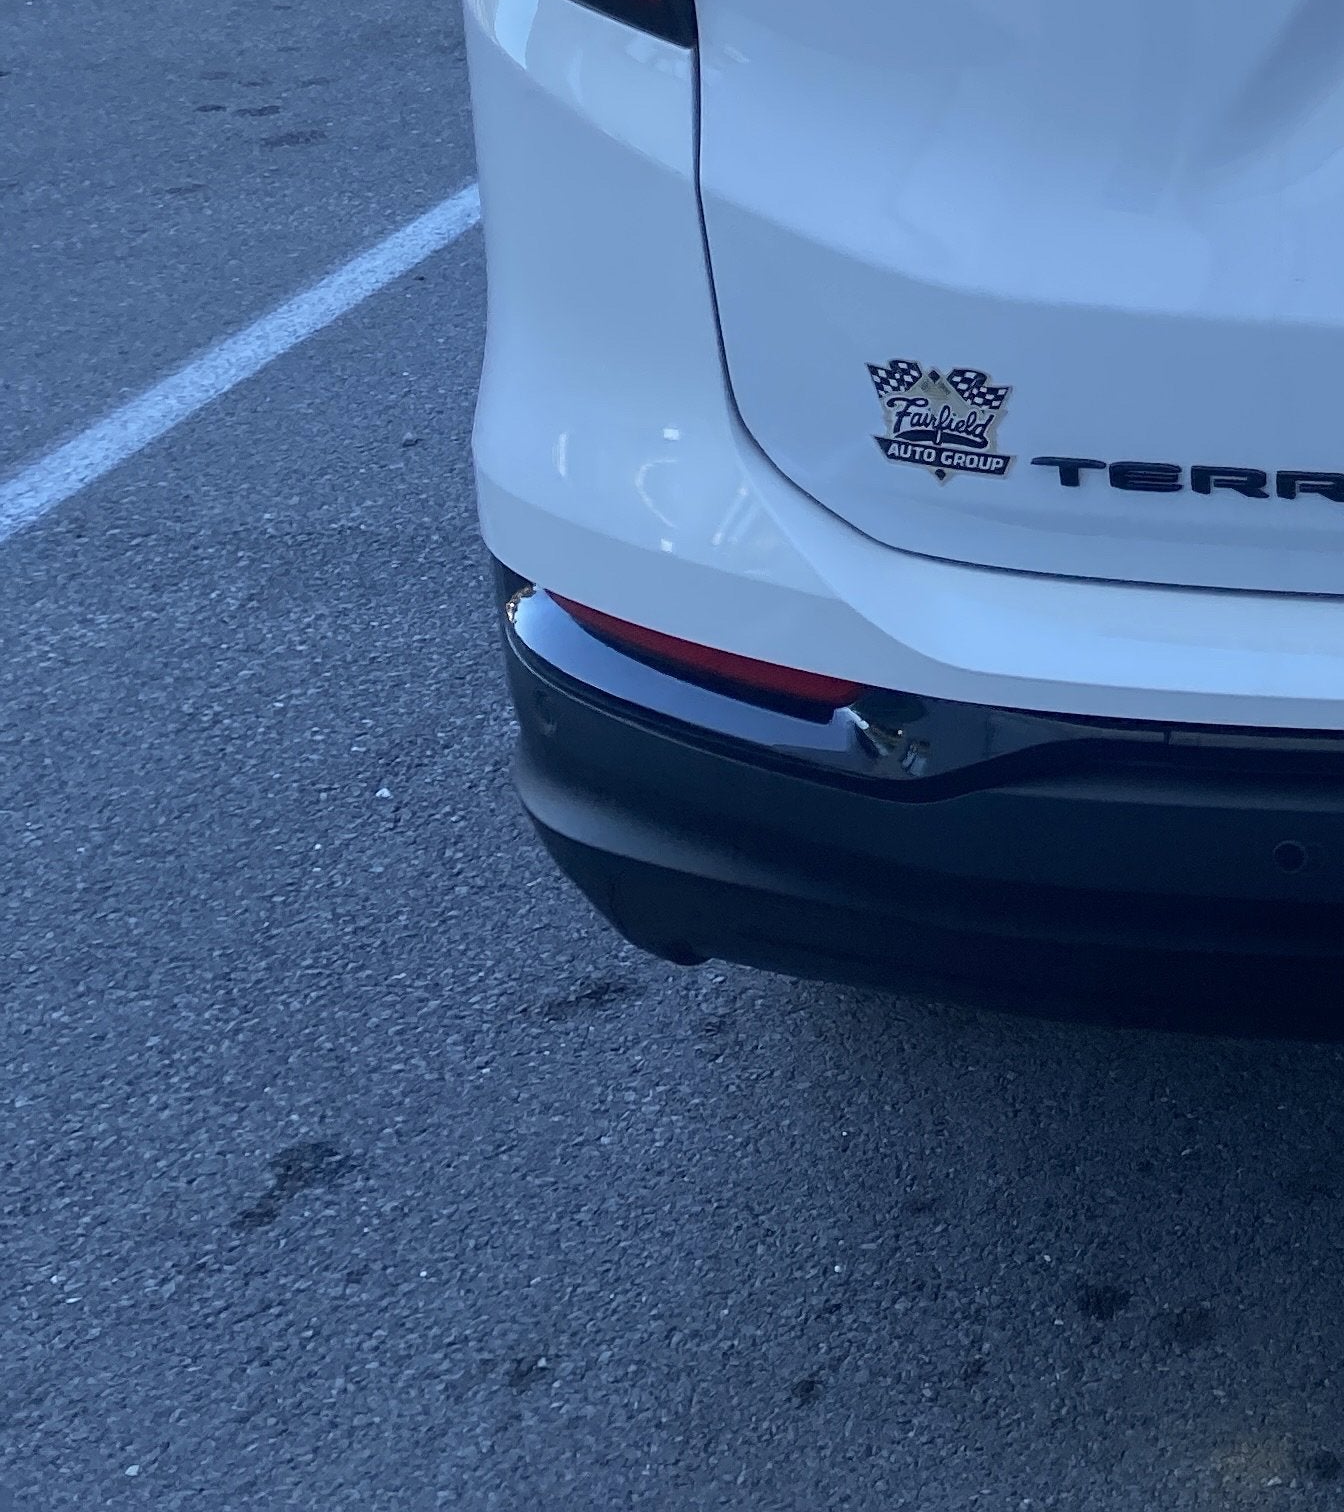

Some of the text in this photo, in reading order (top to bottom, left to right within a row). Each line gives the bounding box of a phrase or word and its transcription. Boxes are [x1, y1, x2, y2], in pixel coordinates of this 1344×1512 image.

[887, 396, 995, 445] Fairfield
[887, 442, 1004, 470] AUTO GROUP
